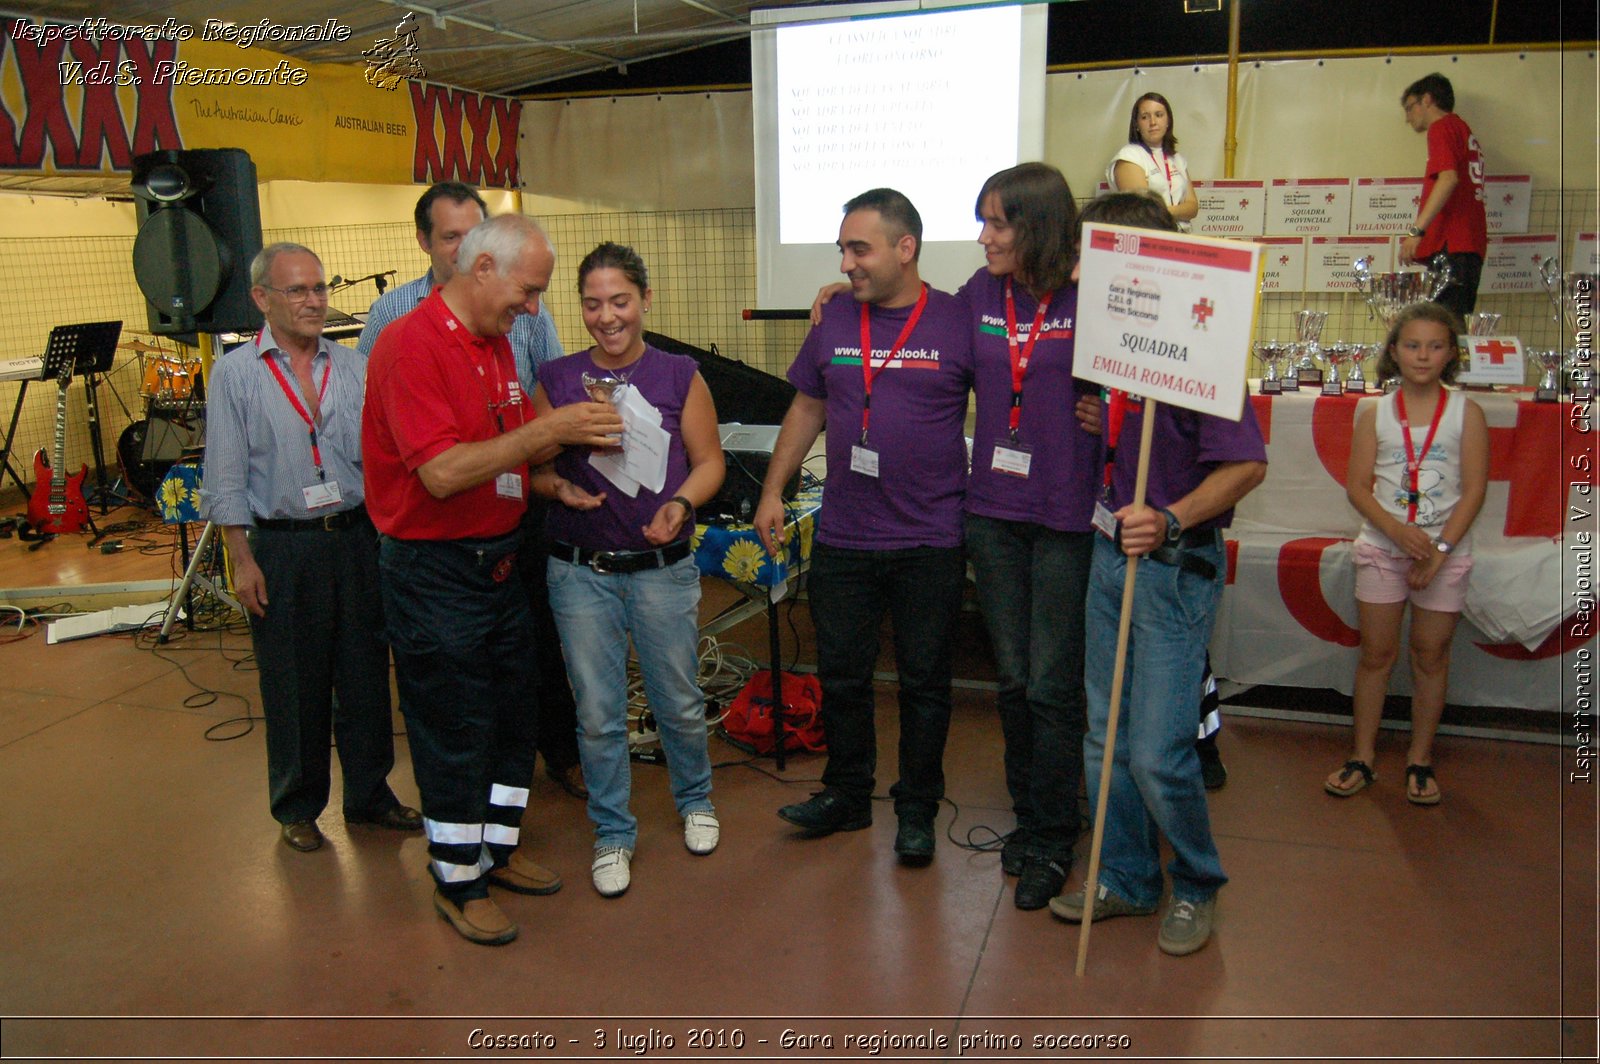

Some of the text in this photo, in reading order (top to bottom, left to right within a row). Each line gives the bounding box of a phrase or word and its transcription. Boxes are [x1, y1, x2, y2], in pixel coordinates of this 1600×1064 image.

[190, 98, 303, 126] The Australian Classic
[334, 115, 408, 137] AUSTRALIAN BEER
[408, 80, 522, 188] XXXX
[1496, 271, 1532, 279] SQUADRA
[1127, 288, 1161, 301] Regionale
[1127, 307, 1159, 321] Soccorso
[1120, 332, 1188, 361] SQUADRA
[1092, 355, 1137, 381] EMILIA
[1141, 368, 1217, 401] ROMAGNA
